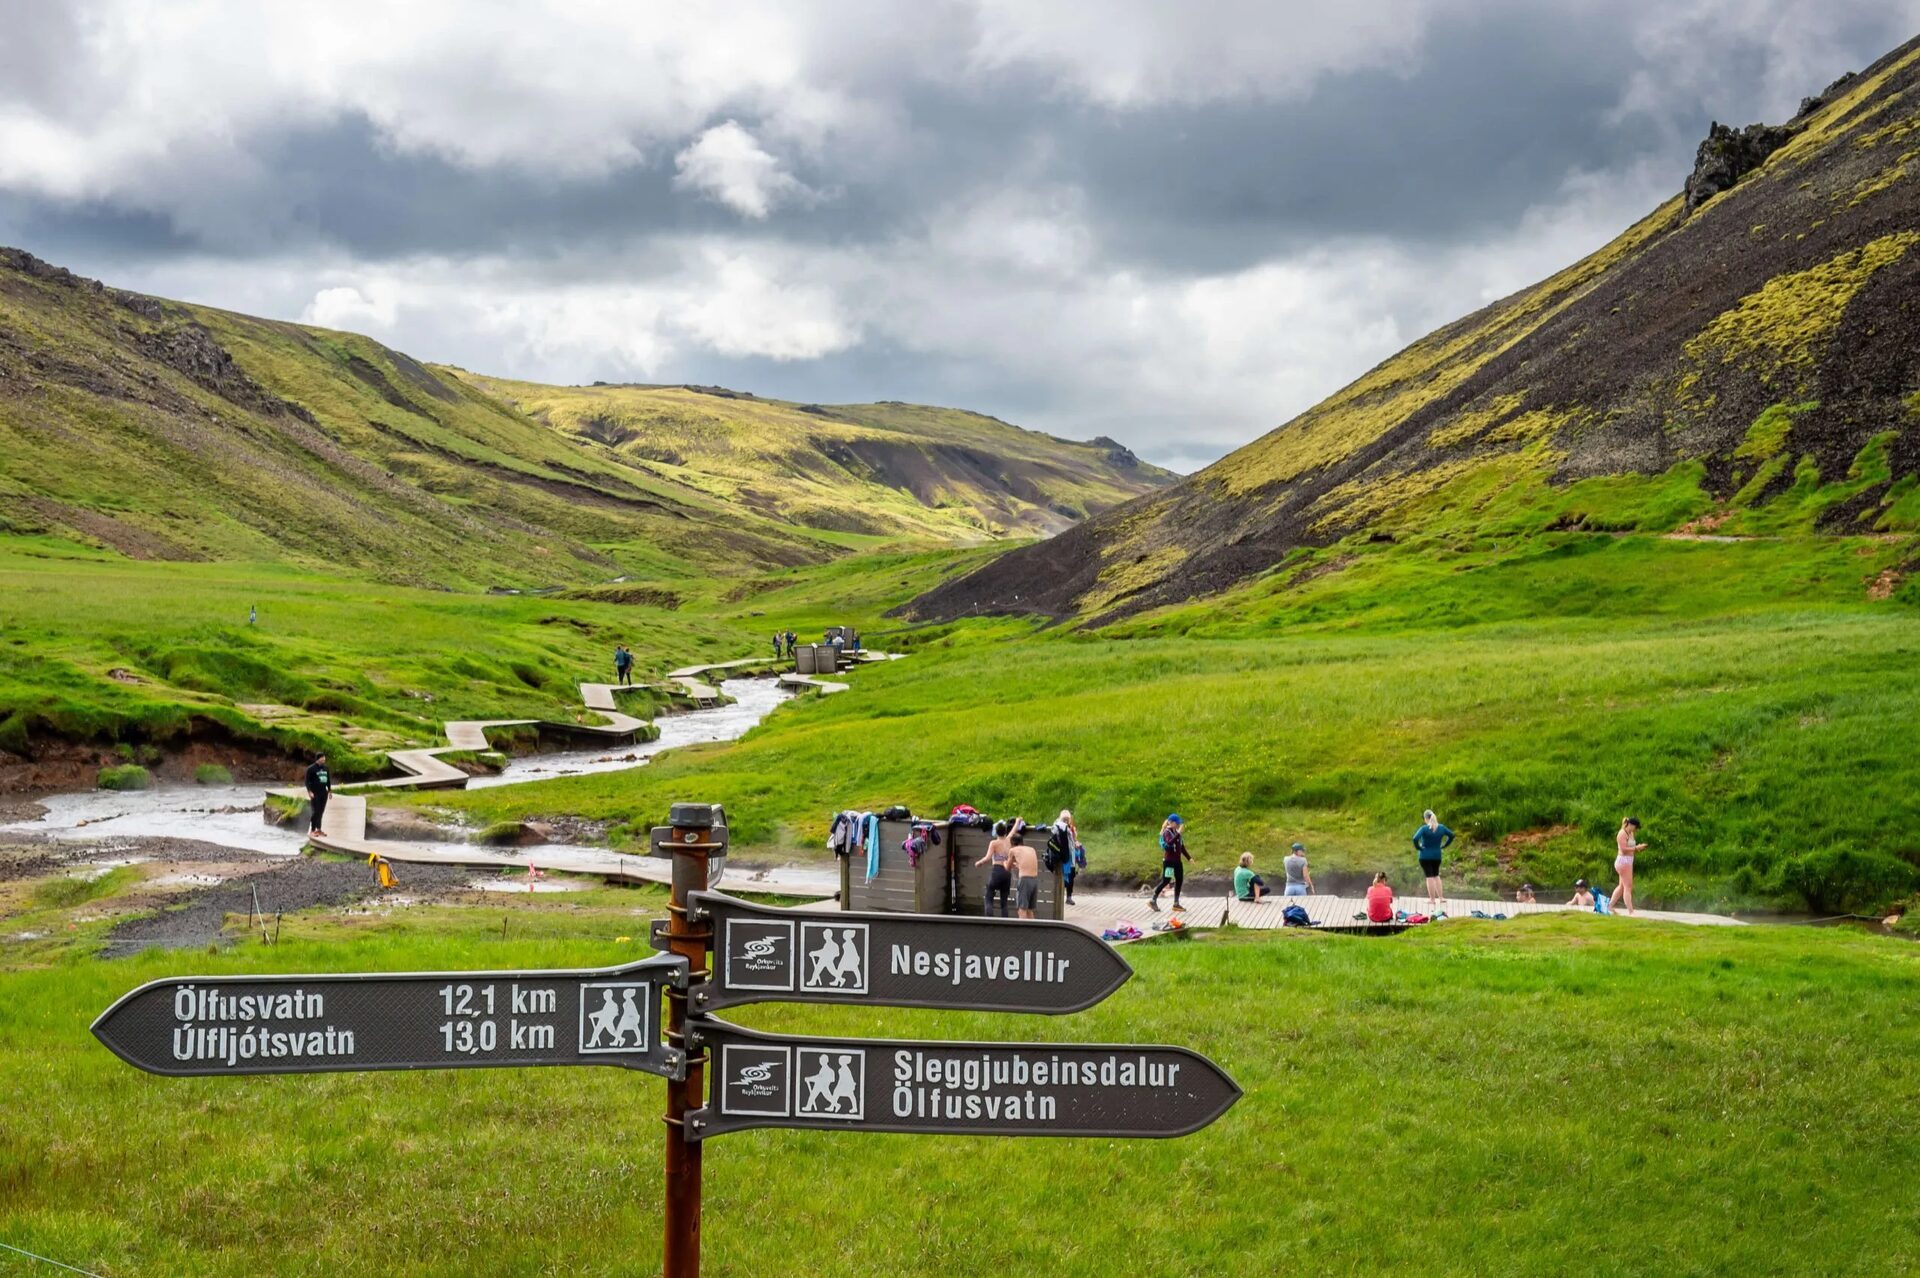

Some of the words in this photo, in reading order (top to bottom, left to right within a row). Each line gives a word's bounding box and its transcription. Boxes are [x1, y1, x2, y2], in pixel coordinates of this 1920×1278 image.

[891, 944, 1070, 985] Nesjavellir
[174, 985, 323, 1021] Ölfusvatn
[439, 984, 495, 1018] 12,1
[512, 984, 556, 1014] km
[173, 1023, 355, 1066] Úlfljótsvatn
[439, 1020, 497, 1055] 13,0
[510, 1019, 555, 1050] km
[894, 1050, 1180, 1091] Sleggjubeinsdalur
[892, 1080, 1056, 1120] Ölfusvatn
